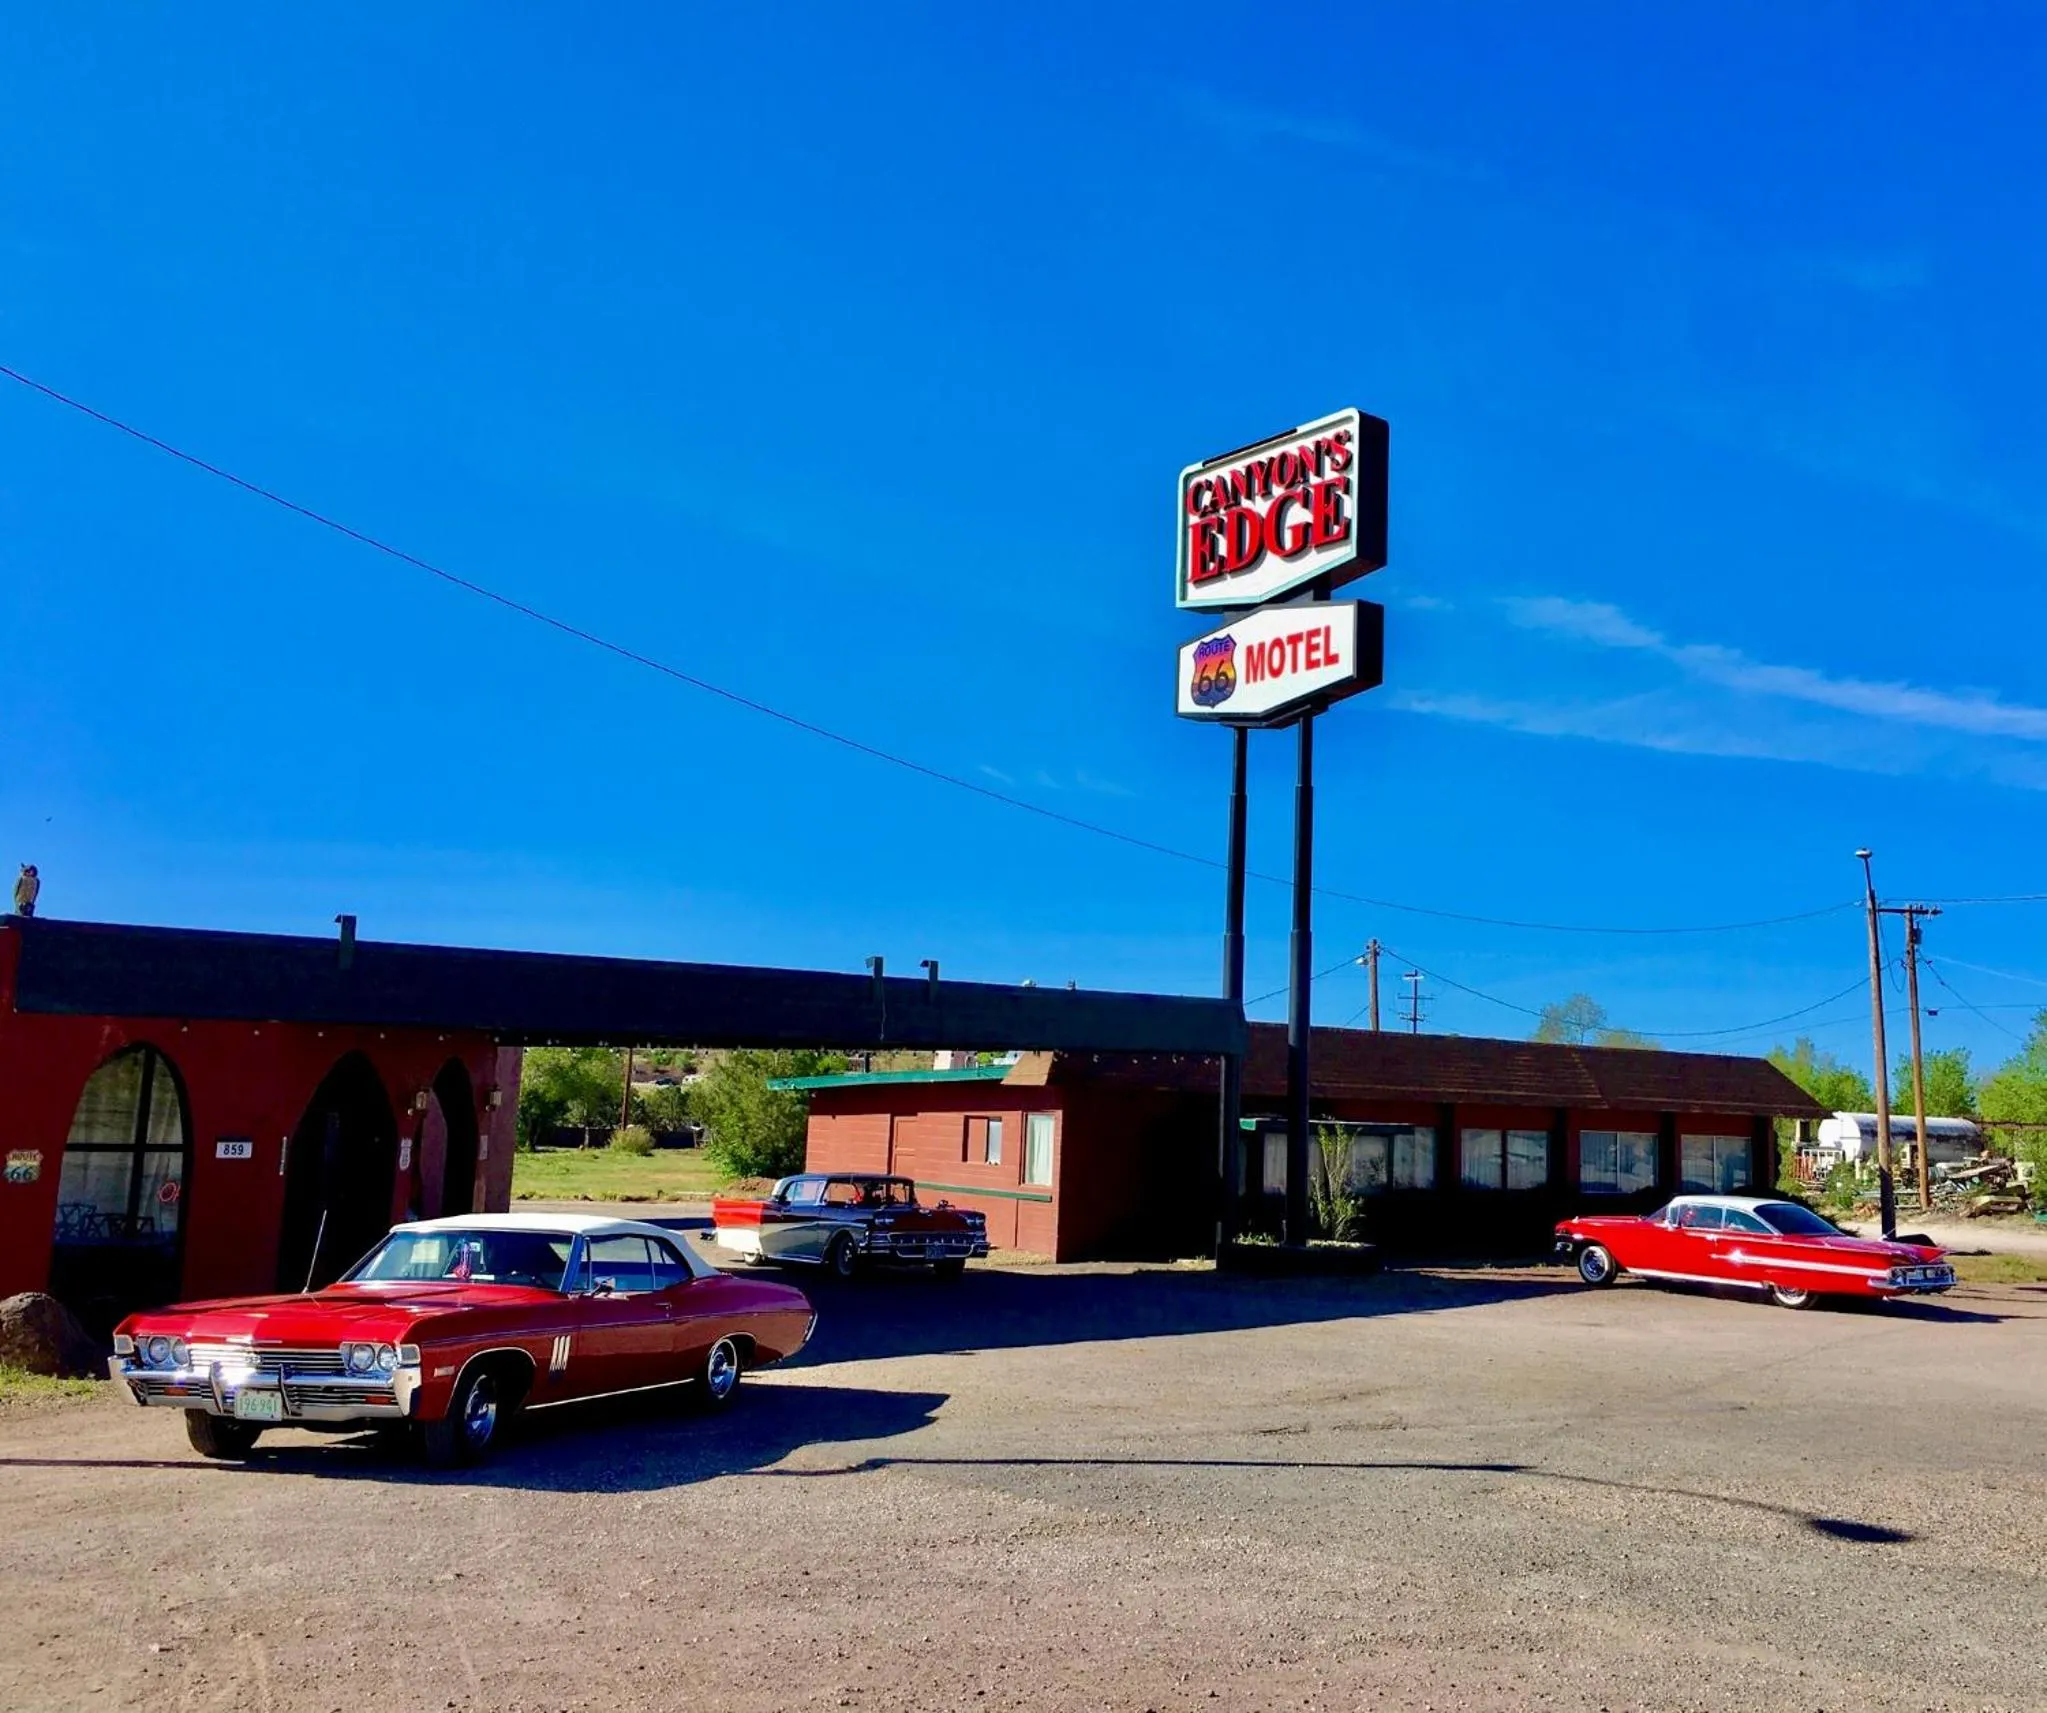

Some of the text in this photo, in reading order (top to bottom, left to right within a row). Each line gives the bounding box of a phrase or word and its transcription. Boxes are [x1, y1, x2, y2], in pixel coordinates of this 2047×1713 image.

[1187, 430, 1353, 516] CANYON'S
[1188, 475, 1351, 585] EDGE
[1199, 641, 1231, 658] ROUTE
[1245, 625, 1340, 684] MOTEL
[1199, 659, 1230, 697] 66
[223, 1143, 244, 1156] 859
[10, 1166, 34, 1181] 66
